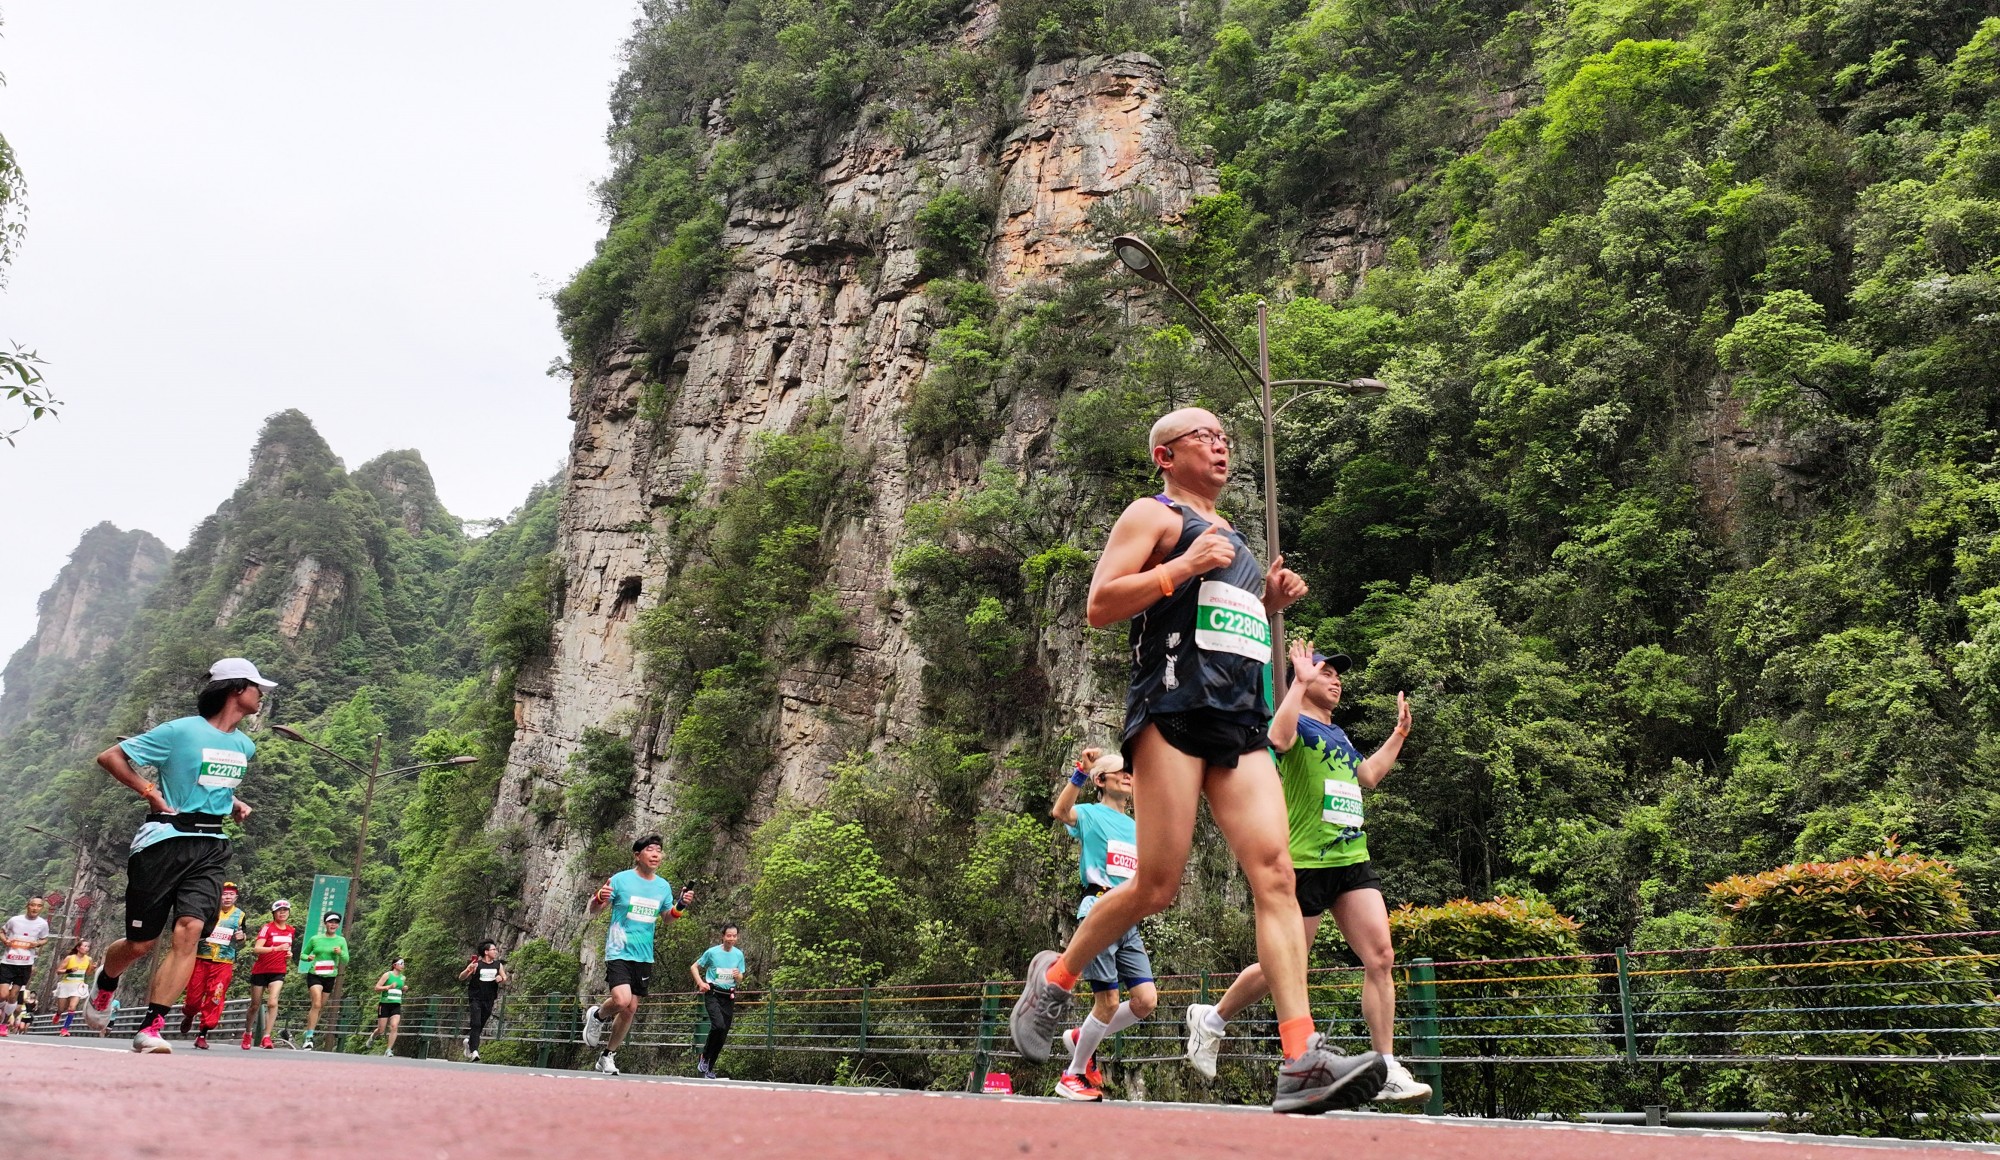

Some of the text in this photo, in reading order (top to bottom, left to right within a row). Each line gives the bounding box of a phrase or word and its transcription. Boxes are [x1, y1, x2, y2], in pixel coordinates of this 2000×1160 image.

[1210, 608, 1266, 642] C22800
[207, 763, 242, 778] C22784
[631, 905, 656, 917] B21333
